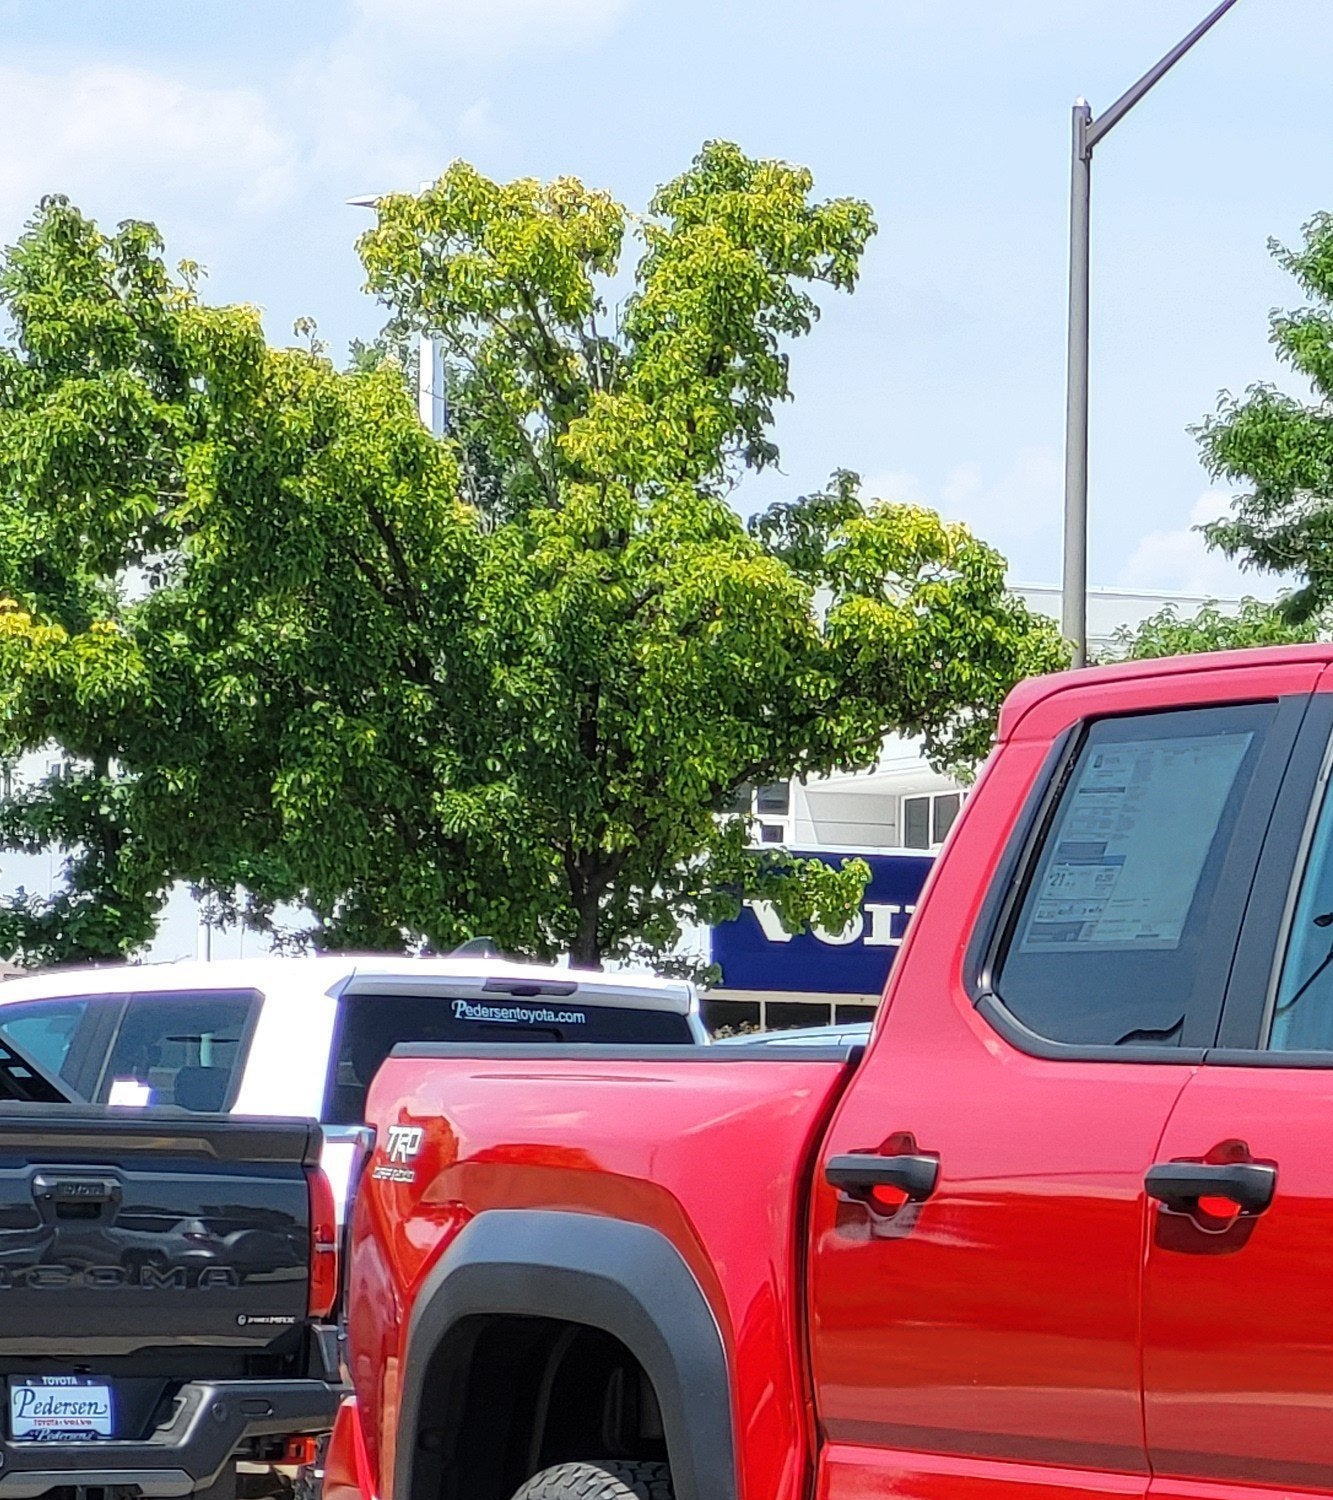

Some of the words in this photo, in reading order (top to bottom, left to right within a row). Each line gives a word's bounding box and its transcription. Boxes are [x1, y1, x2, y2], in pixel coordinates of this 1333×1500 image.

[743, 899, 916, 946] VOL
[451, 999, 586, 1024] Pedersentoyota.com
[387, 1125, 423, 1163] TRD
[41, 1376, 78, 1385] TOYOTA
[14, 1388, 108, 1418] Pedersen
